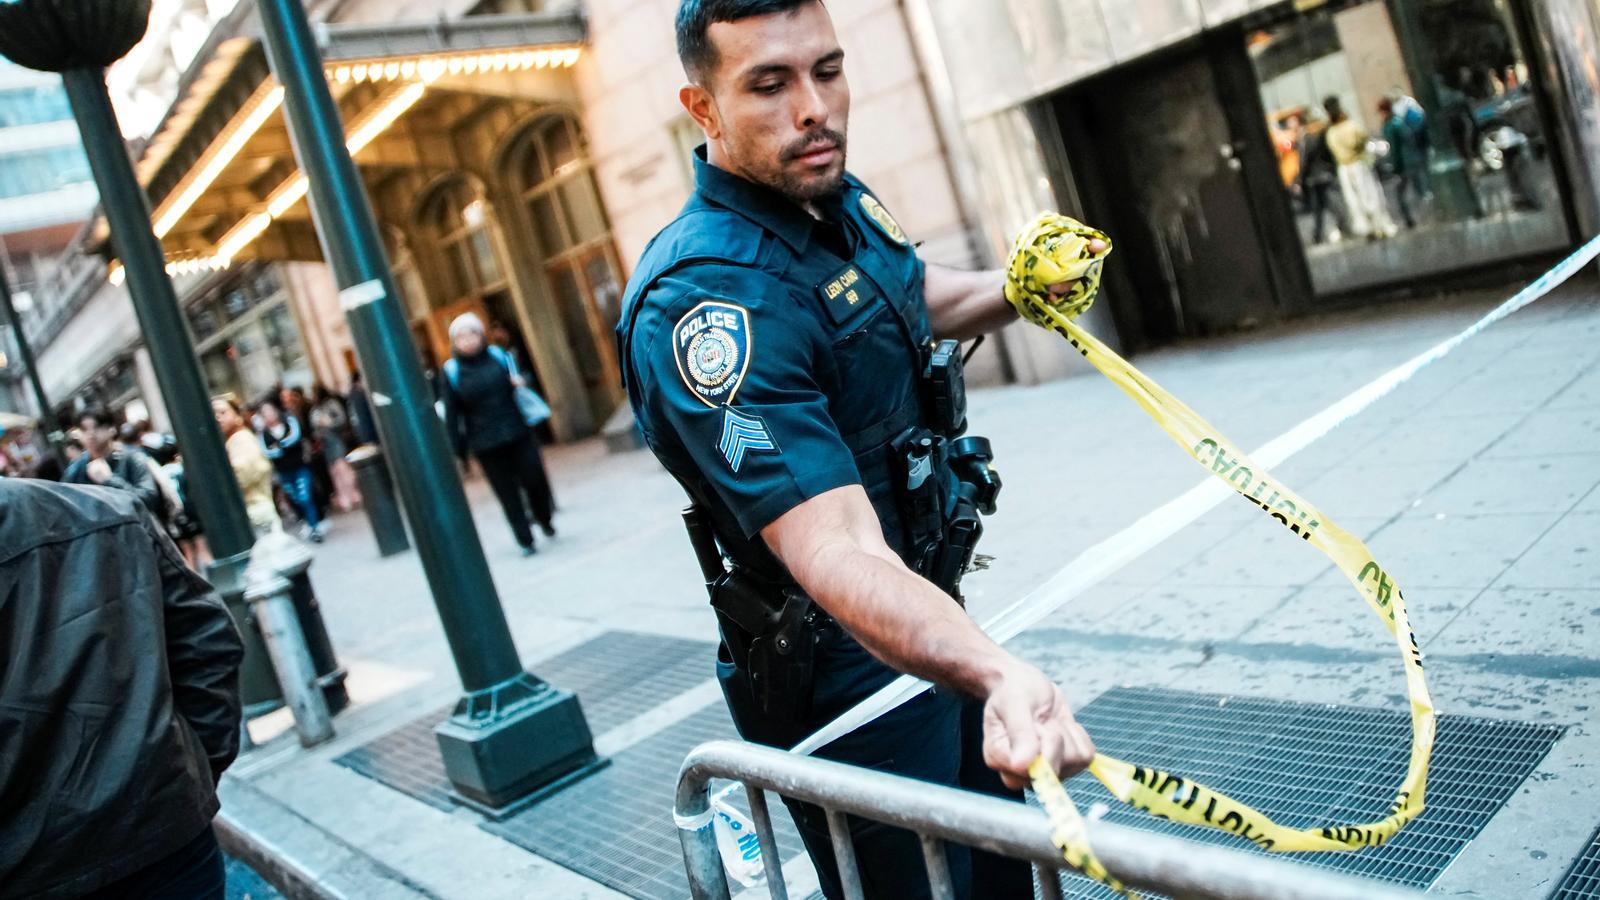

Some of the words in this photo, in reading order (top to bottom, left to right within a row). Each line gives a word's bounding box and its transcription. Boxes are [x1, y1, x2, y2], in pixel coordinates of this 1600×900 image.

[680, 311, 739, 348] POLICE
[695, 384, 710, 396] NEW
[709, 385, 725, 397] YORK
[723, 372, 740, 390] STATE
